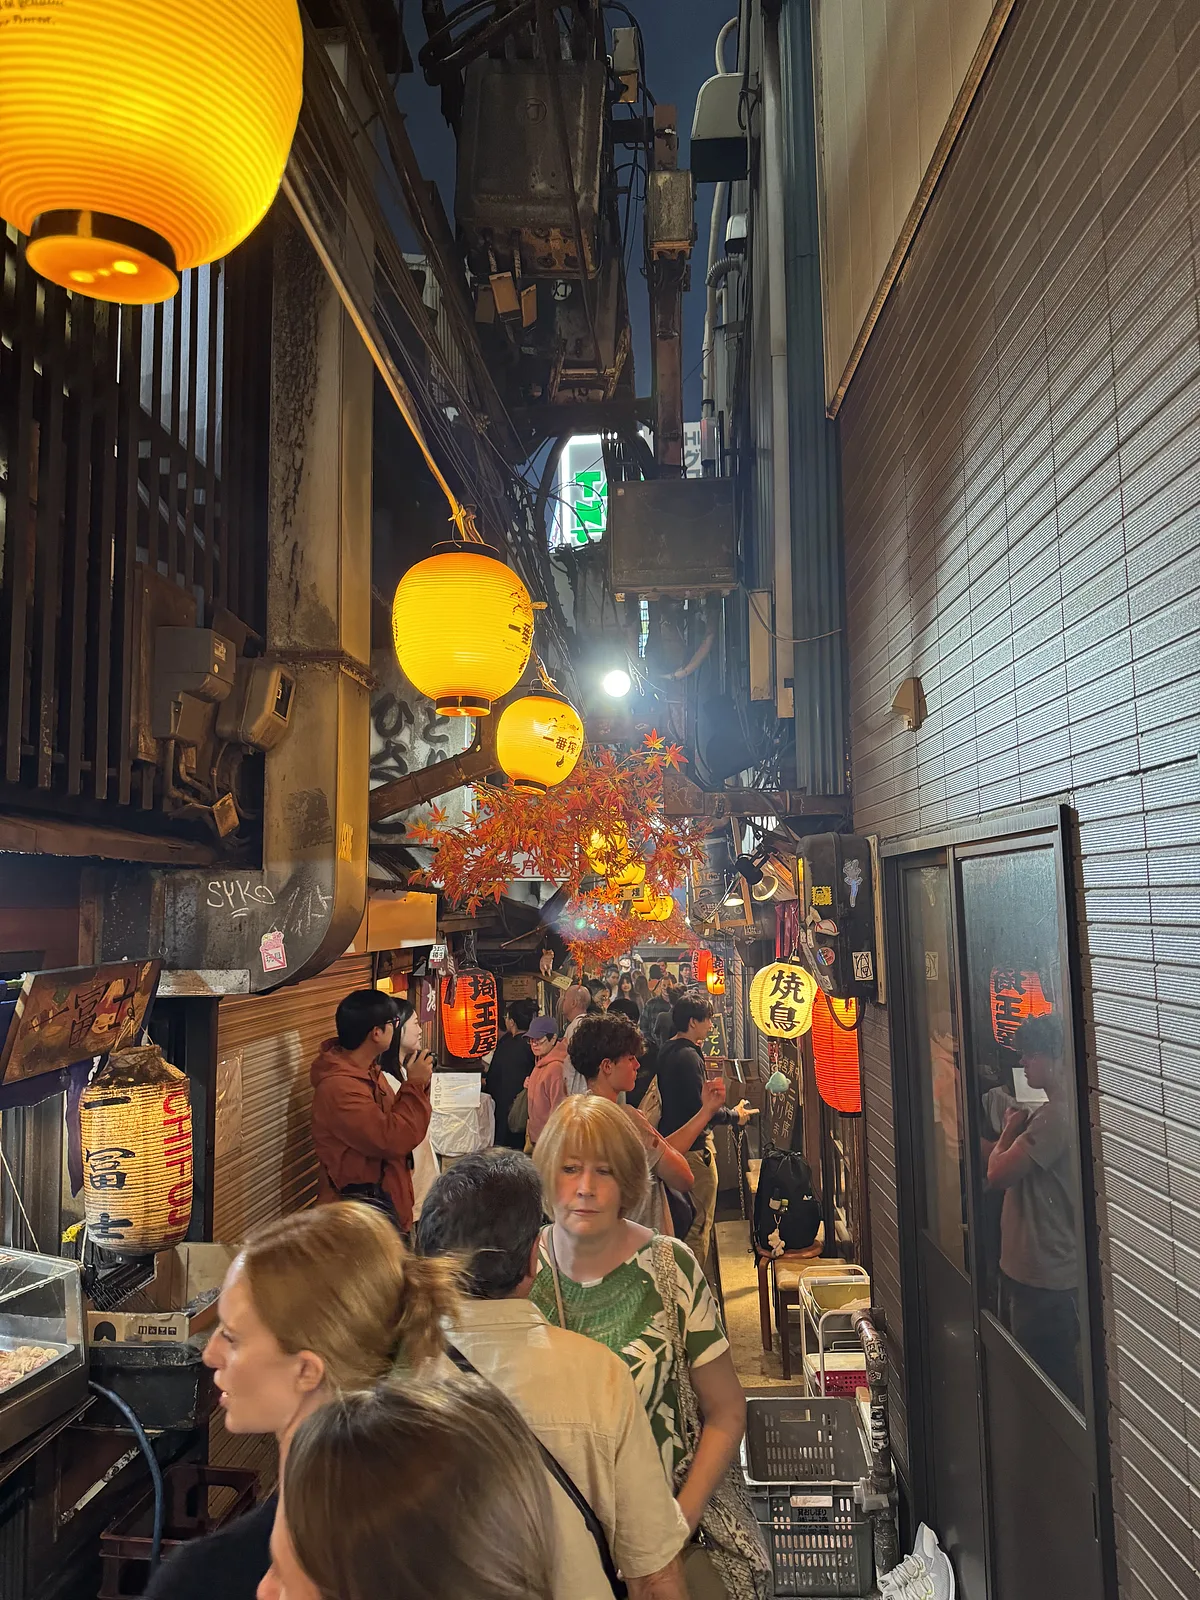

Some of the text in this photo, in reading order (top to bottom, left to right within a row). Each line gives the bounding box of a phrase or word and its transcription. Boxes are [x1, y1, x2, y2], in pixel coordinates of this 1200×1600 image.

[468, 974, 497, 1055] 埼玉屋
[765, 969, 805, 1032] 焼鳥
